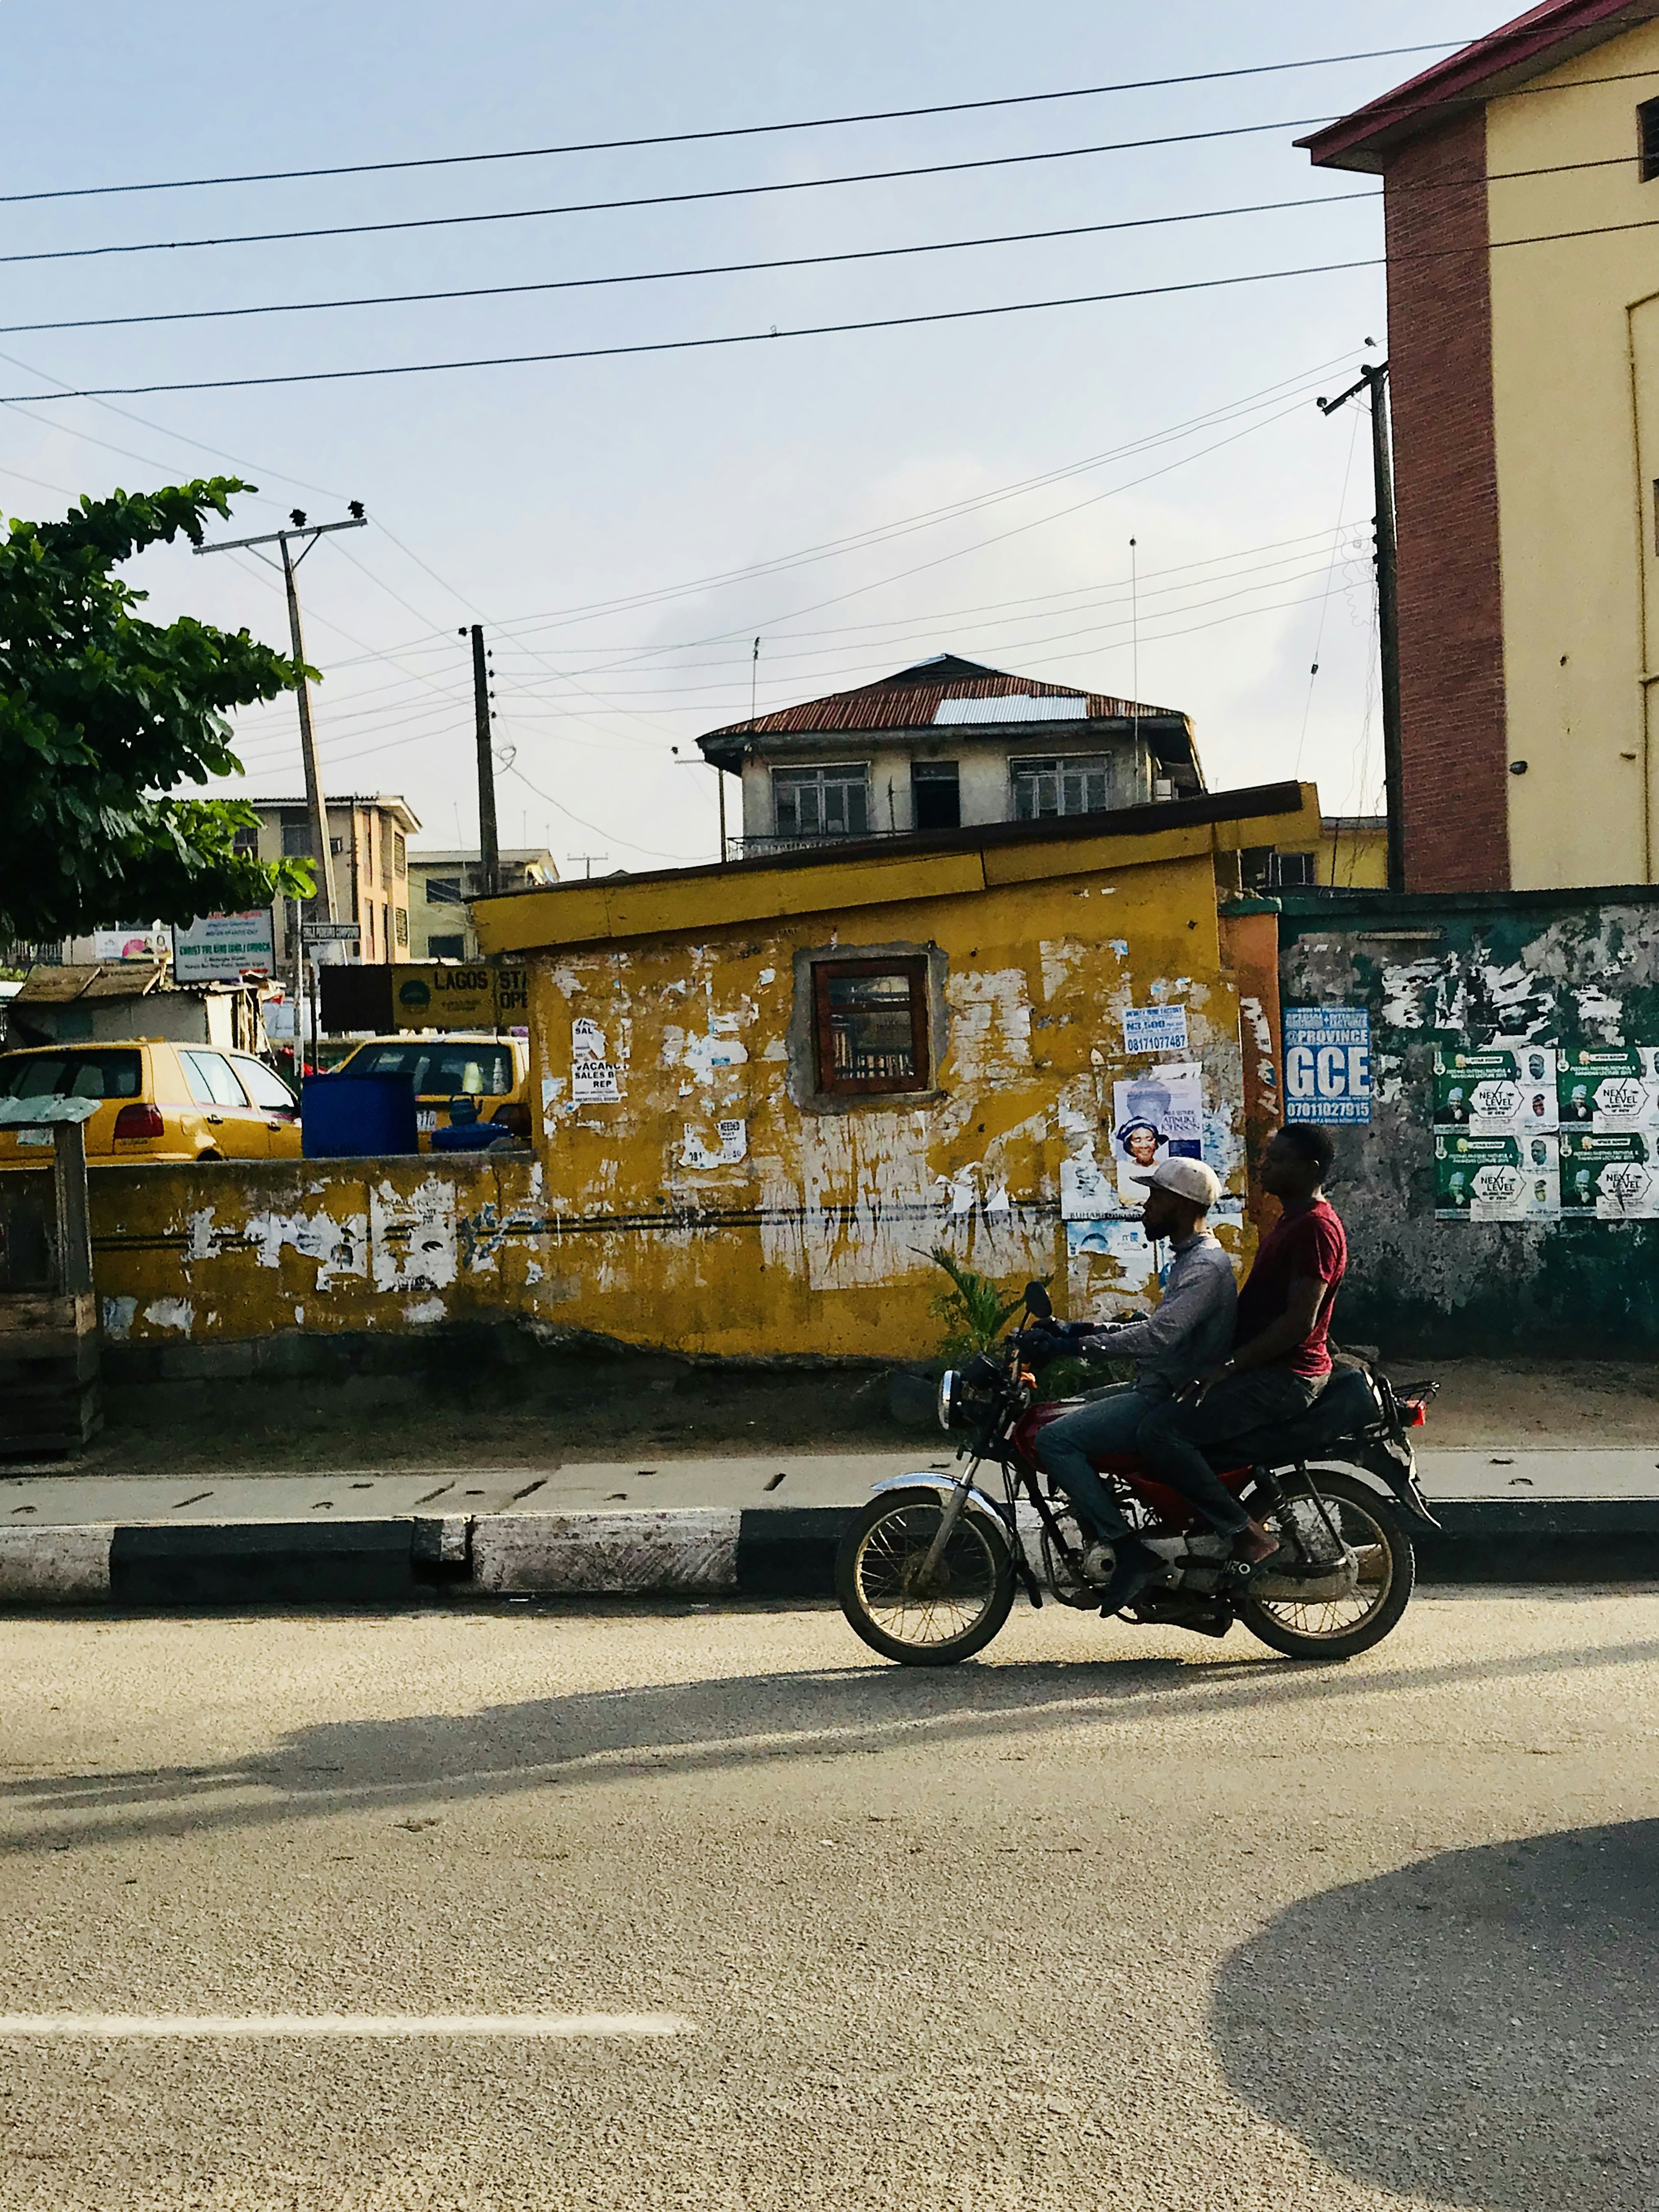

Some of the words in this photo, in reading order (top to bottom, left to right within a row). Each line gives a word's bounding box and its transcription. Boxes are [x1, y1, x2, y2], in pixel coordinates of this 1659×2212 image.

[434, 971, 488, 990] LAGOS
[1128, 1035, 1185, 1051] 08171077487
[1287, 1046, 1369, 1097] GCE
[1287, 1102, 1369, 1117] 07011027915
[1161, 1123, 1200, 1133] JOHNSON
